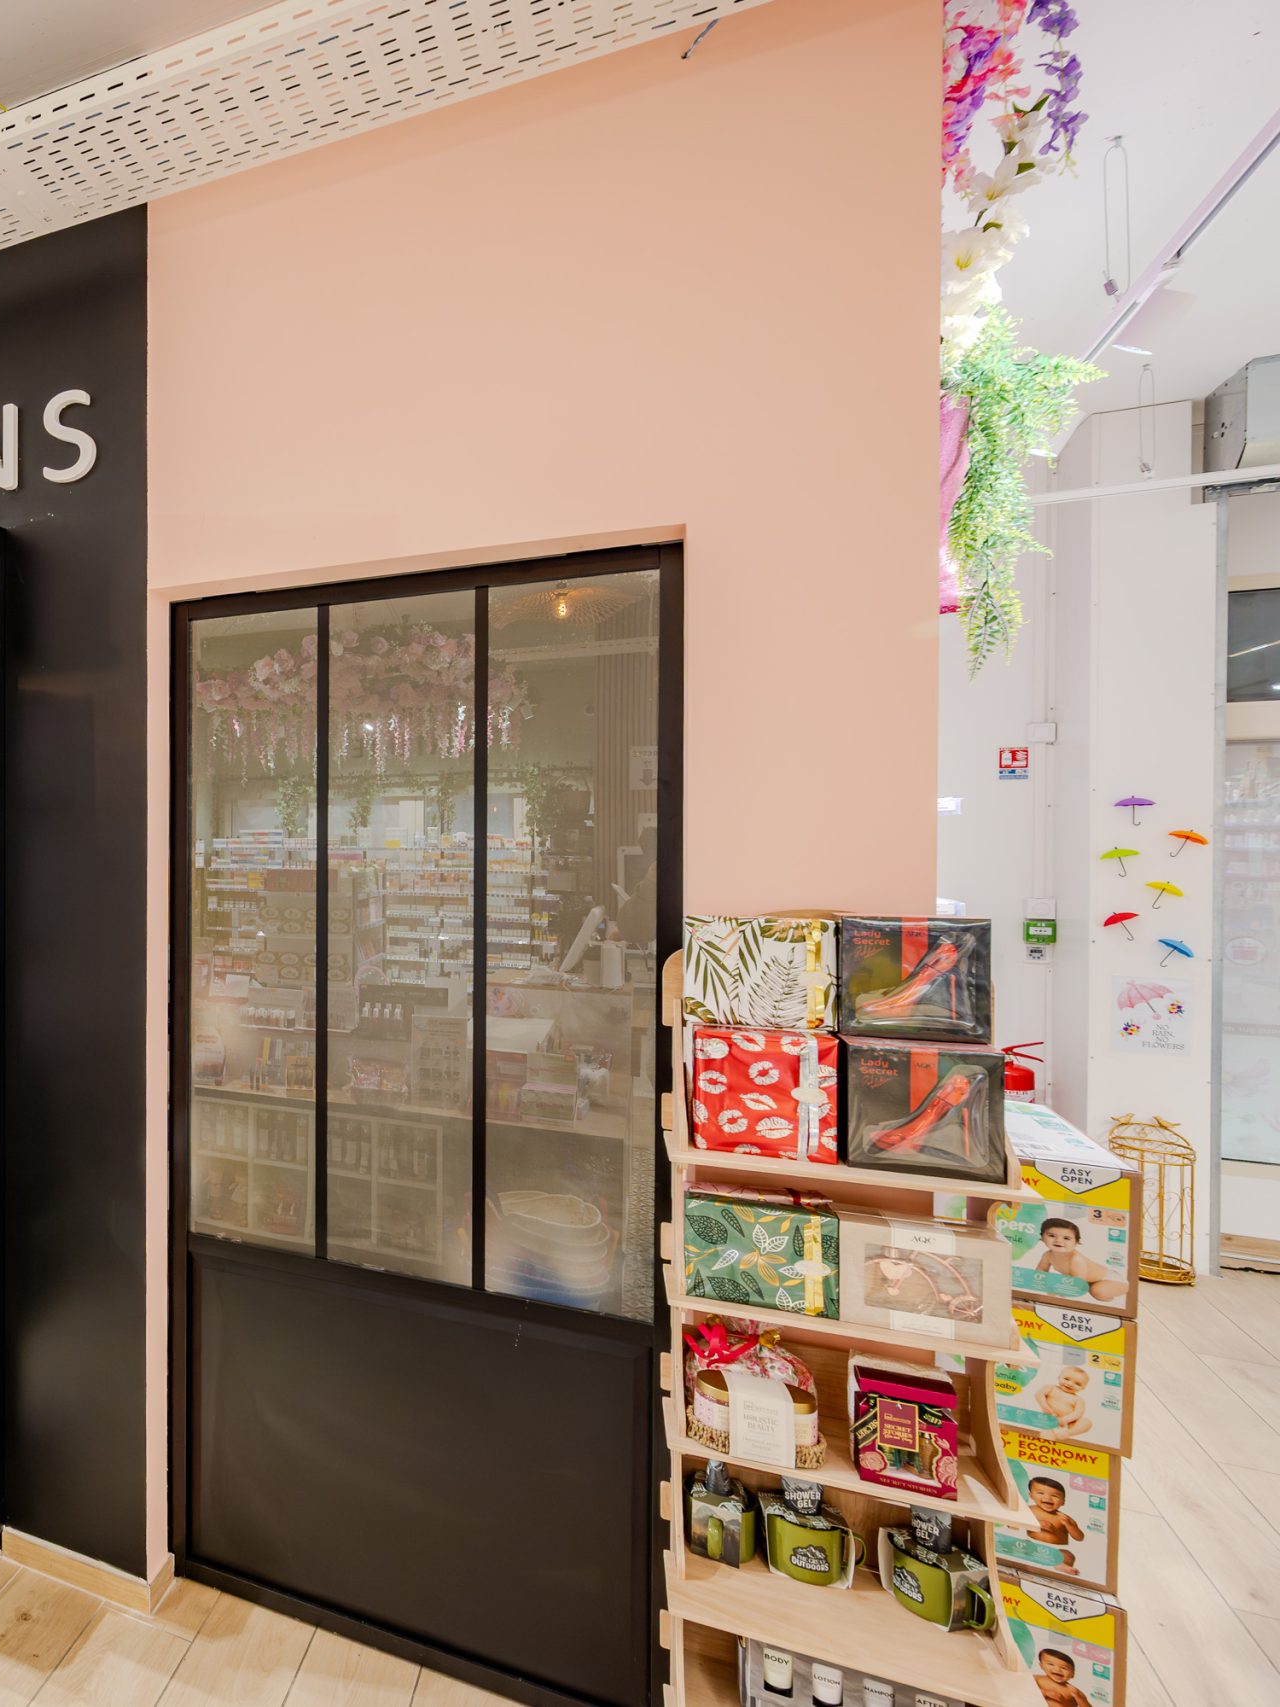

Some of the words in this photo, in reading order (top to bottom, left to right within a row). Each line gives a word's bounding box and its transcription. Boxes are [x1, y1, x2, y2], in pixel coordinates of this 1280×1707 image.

[854, 929, 881, 939] Lady
[853, 937, 891, 946] Secret
[1141, 1041, 1185, 1051] FLOWERS
[860, 1058, 889, 1069] Lady
[859, 1066, 898, 1077] Secret
[1062, 1166, 1092, 1178] EASY
[1060, 1175, 1093, 1186] OPEN
[1093, 1209, 1102, 1219] 3
[1062, 1313, 1091, 1325] EASY
[1060, 1321, 1093, 1334] OPEN
[1091, 1354, 1100, 1363] 2
[743, 1413, 777, 1426] HOLISTIC
[747, 1421, 775, 1433] BEAUTY
[883, 1423, 912, 1433] SECRET
[1018, 1439, 1099, 1465] ECONOMY
[784, 1491, 821, 1501] SHOWER
[797, 1500, 813, 1509] GEL
[915, 1528, 931, 1540] GEL
[791, 1555, 830, 1573] OUTDOORS
[1047, 1592, 1077, 1607] EASY
[1045, 1599, 1078, 1616] OPEN
[764, 1653, 790, 1666] BODY
[812, 1673, 841, 1687] LOTION
